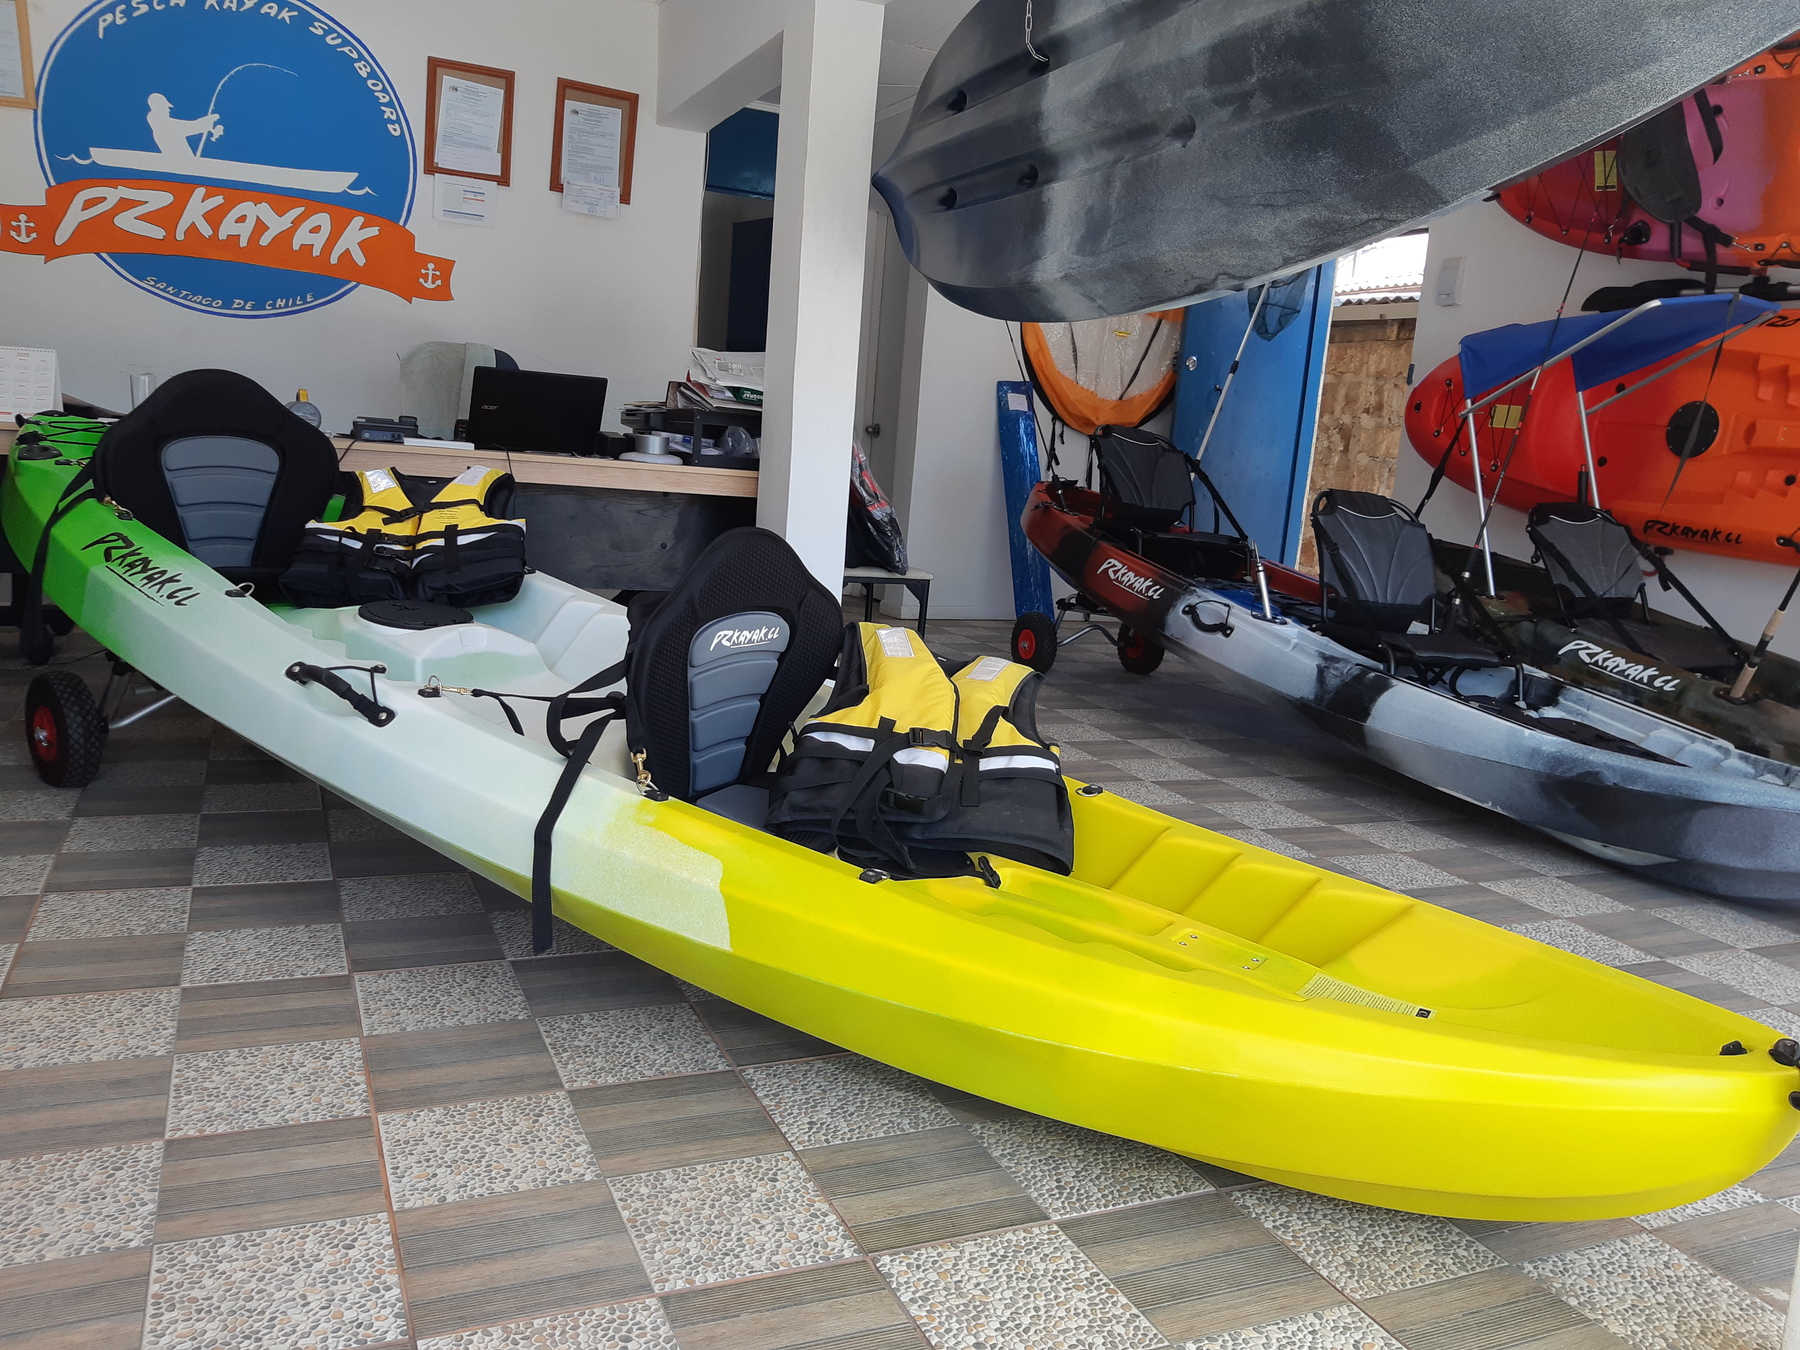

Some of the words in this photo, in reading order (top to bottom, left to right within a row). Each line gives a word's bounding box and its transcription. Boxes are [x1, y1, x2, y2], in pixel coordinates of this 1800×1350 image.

[204, 0, 299, 24] KAYAK
[308, 21, 401, 137] SUPBOARD
[54, 185, 381, 267] PZKAYAK
[142, 276, 222, 308] SANTIAGO
[231, 298, 256, 310] DE
[265, 292, 314, 310] CHILE
